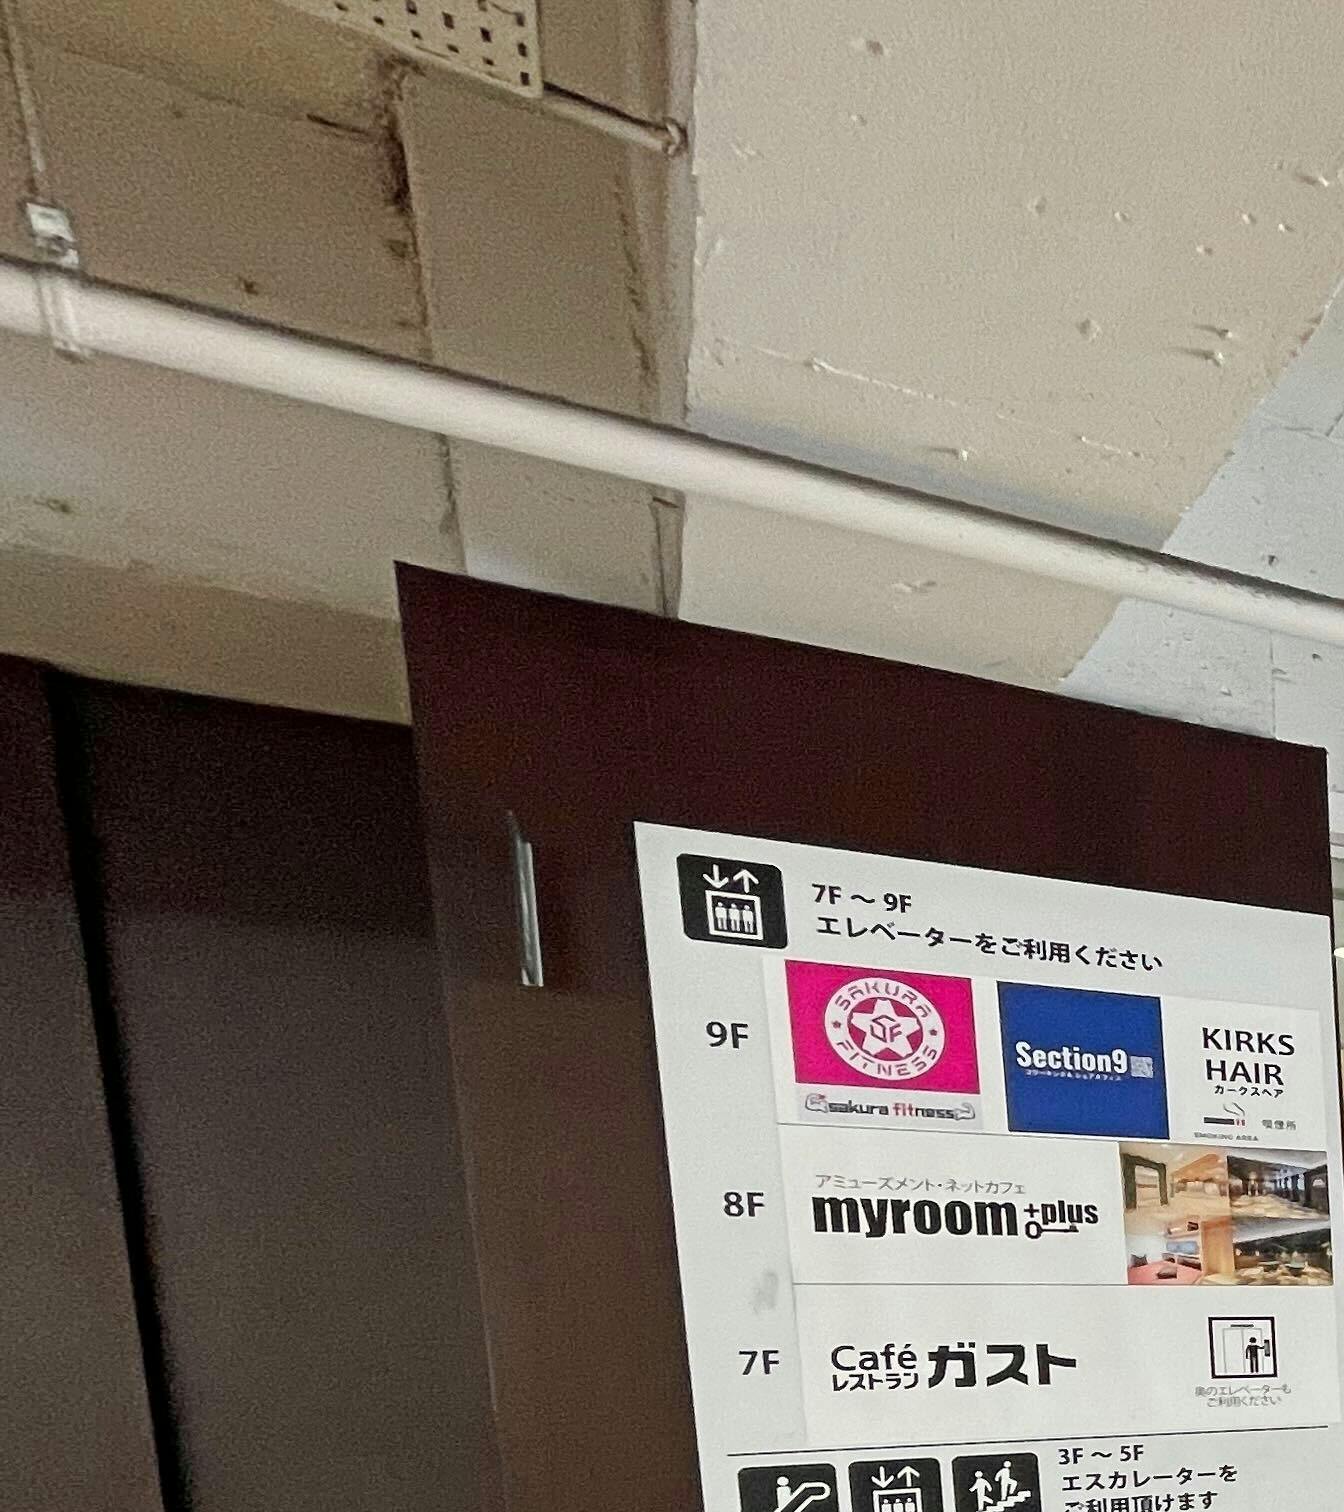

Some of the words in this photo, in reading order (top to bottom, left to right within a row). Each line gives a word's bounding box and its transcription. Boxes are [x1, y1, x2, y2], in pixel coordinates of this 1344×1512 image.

[812, 883, 841, 904] 7F
[884, 892, 912, 913] 9F
[816, 916, 1164, 973] エレベーターをご利用ください
[705, 1021, 749, 1050] 9F
[1202, 1026, 1295, 1056] KIRKS
[836, 1040, 938, 1078] FITNESS
[1016, 1040, 1128, 1074] Section9
[1205, 1058, 1284, 1086] HAIR
[1214, 1084, 1284, 1099] カークスヘア
[828, 1099, 889, 1116] sakura
[892, 1102, 955, 1120] fitness
[815, 1173, 1027, 1195] アミューズメント・ネットカフェ
[722, 1190, 765, 1219] 8F
[811, 1196, 1019, 1238] myroom
[738, 1350, 780, 1376] 7F
[830, 1343, 917, 1372] Café
[927, 1342, 1077, 1388] ガスト
[832, 1372, 919, 1392] レストラン
[1058, 1447, 1084, 1465] 3F
[1120, 1444, 1144, 1462] 5F
[1062, 1464, 1238, 1492] エスカレーターを
